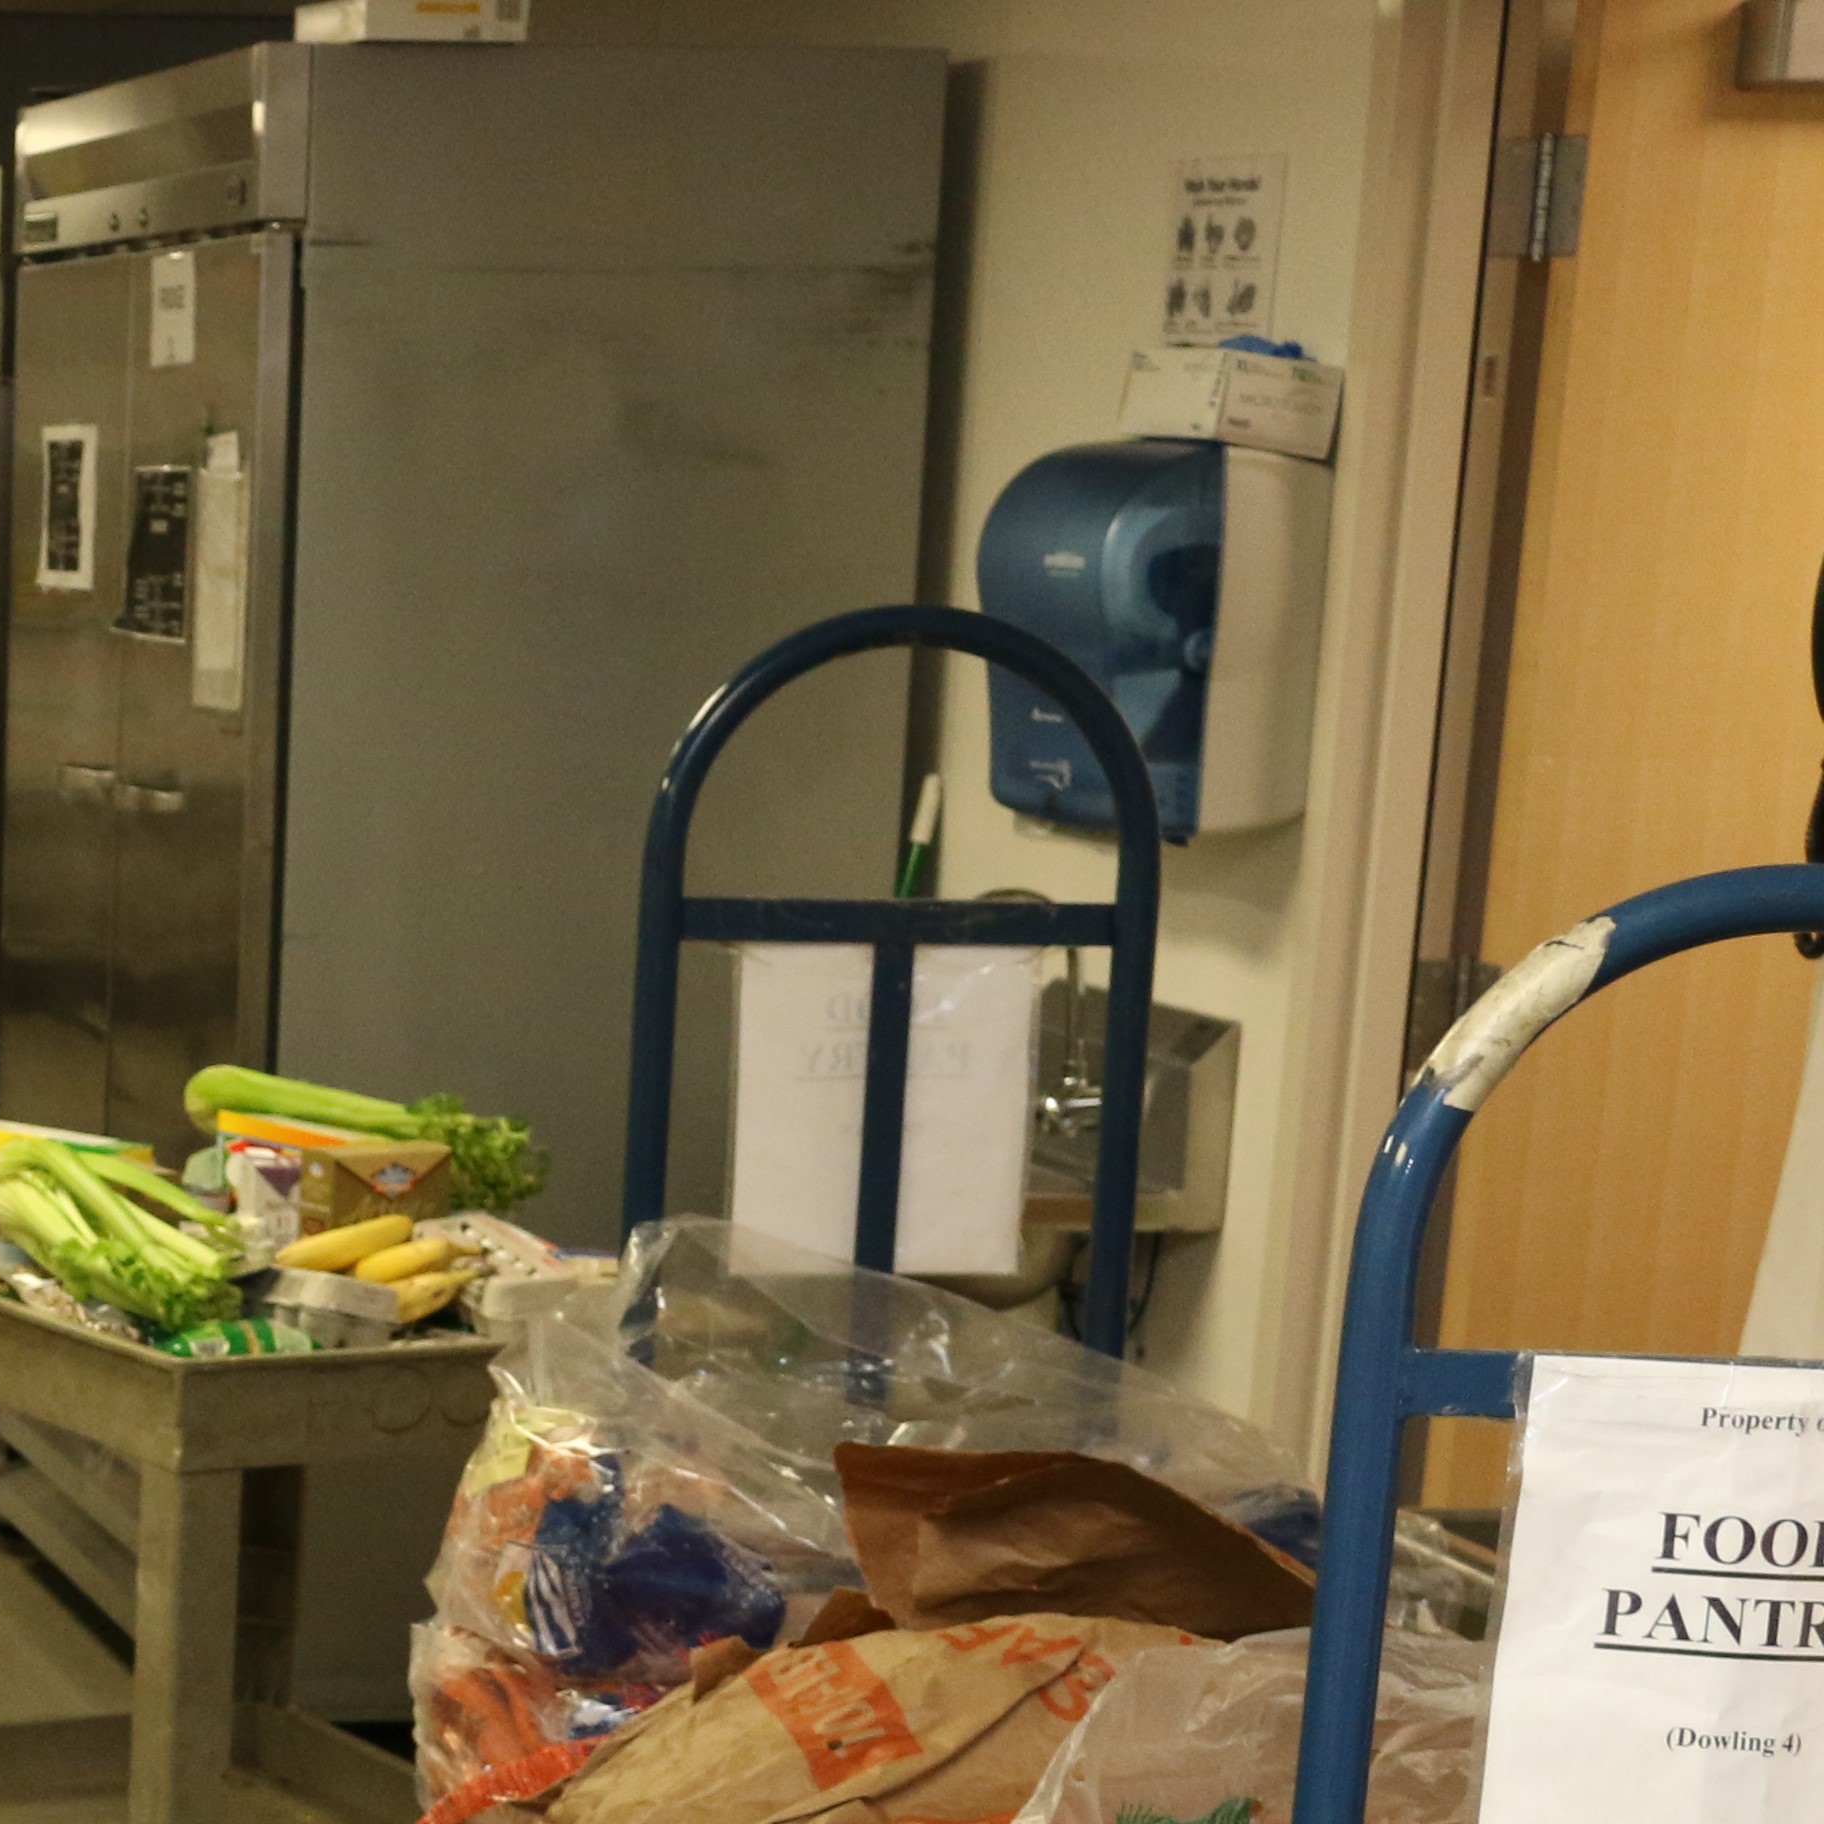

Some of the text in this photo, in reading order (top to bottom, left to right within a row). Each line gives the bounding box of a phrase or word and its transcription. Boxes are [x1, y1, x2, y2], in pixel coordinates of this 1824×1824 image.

[1700, 1406, 1809, 1436] Property
[1598, 1588, 1824, 1651] PANTR
[1665, 1726, 1802, 1757] (Dowling 4)
